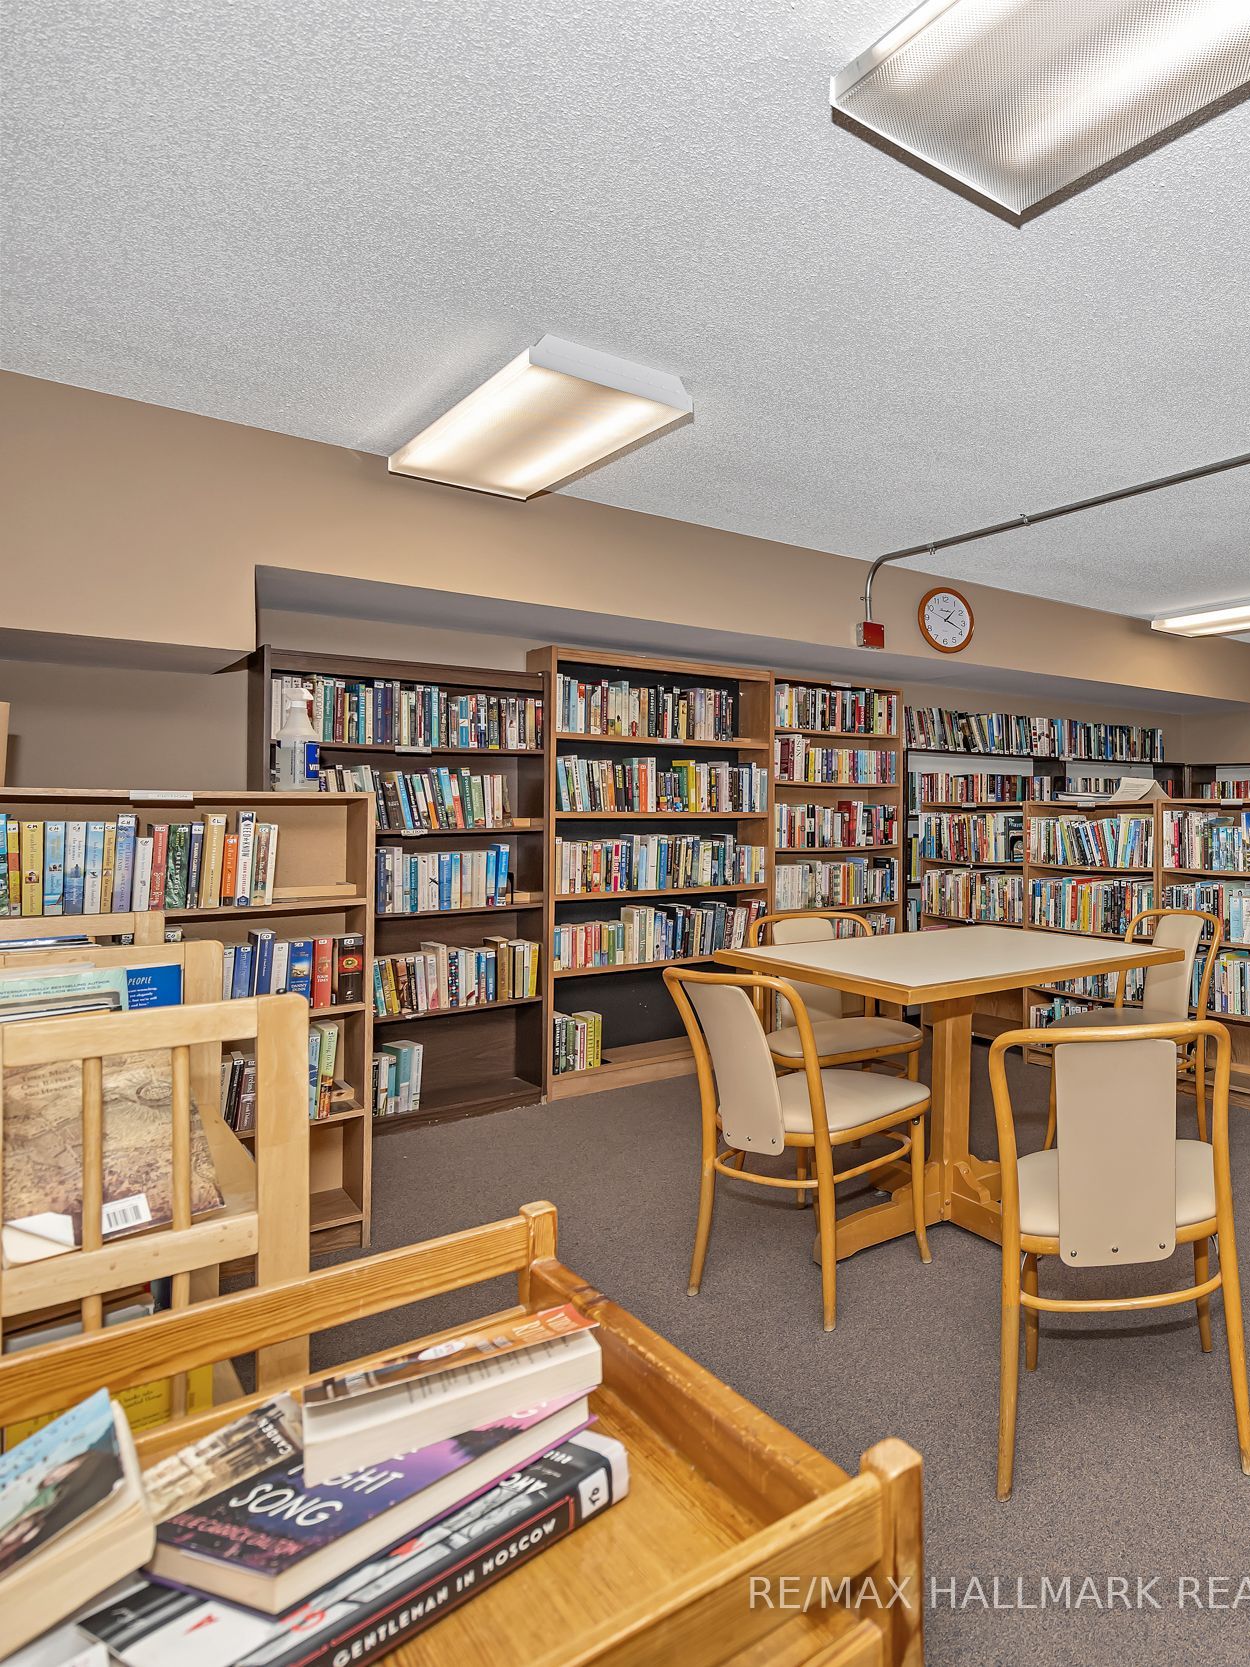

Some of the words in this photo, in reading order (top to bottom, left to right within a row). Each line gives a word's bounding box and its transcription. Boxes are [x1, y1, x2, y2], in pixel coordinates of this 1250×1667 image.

[173, 852, 181, 894] GREENWOOD
[0, 986, 50, 996] NTERNATIONALLY
[50, 983, 86, 991] BESTSELLING
[128, 976, 152, 986] PEOPLE
[229, 1482, 343, 1527] SONG
[332, 1586, 449, 1667] GENTLEMAN
[456, 1569, 476, 1593] IN
[482, 1518, 557, 1576] MOSCOW
